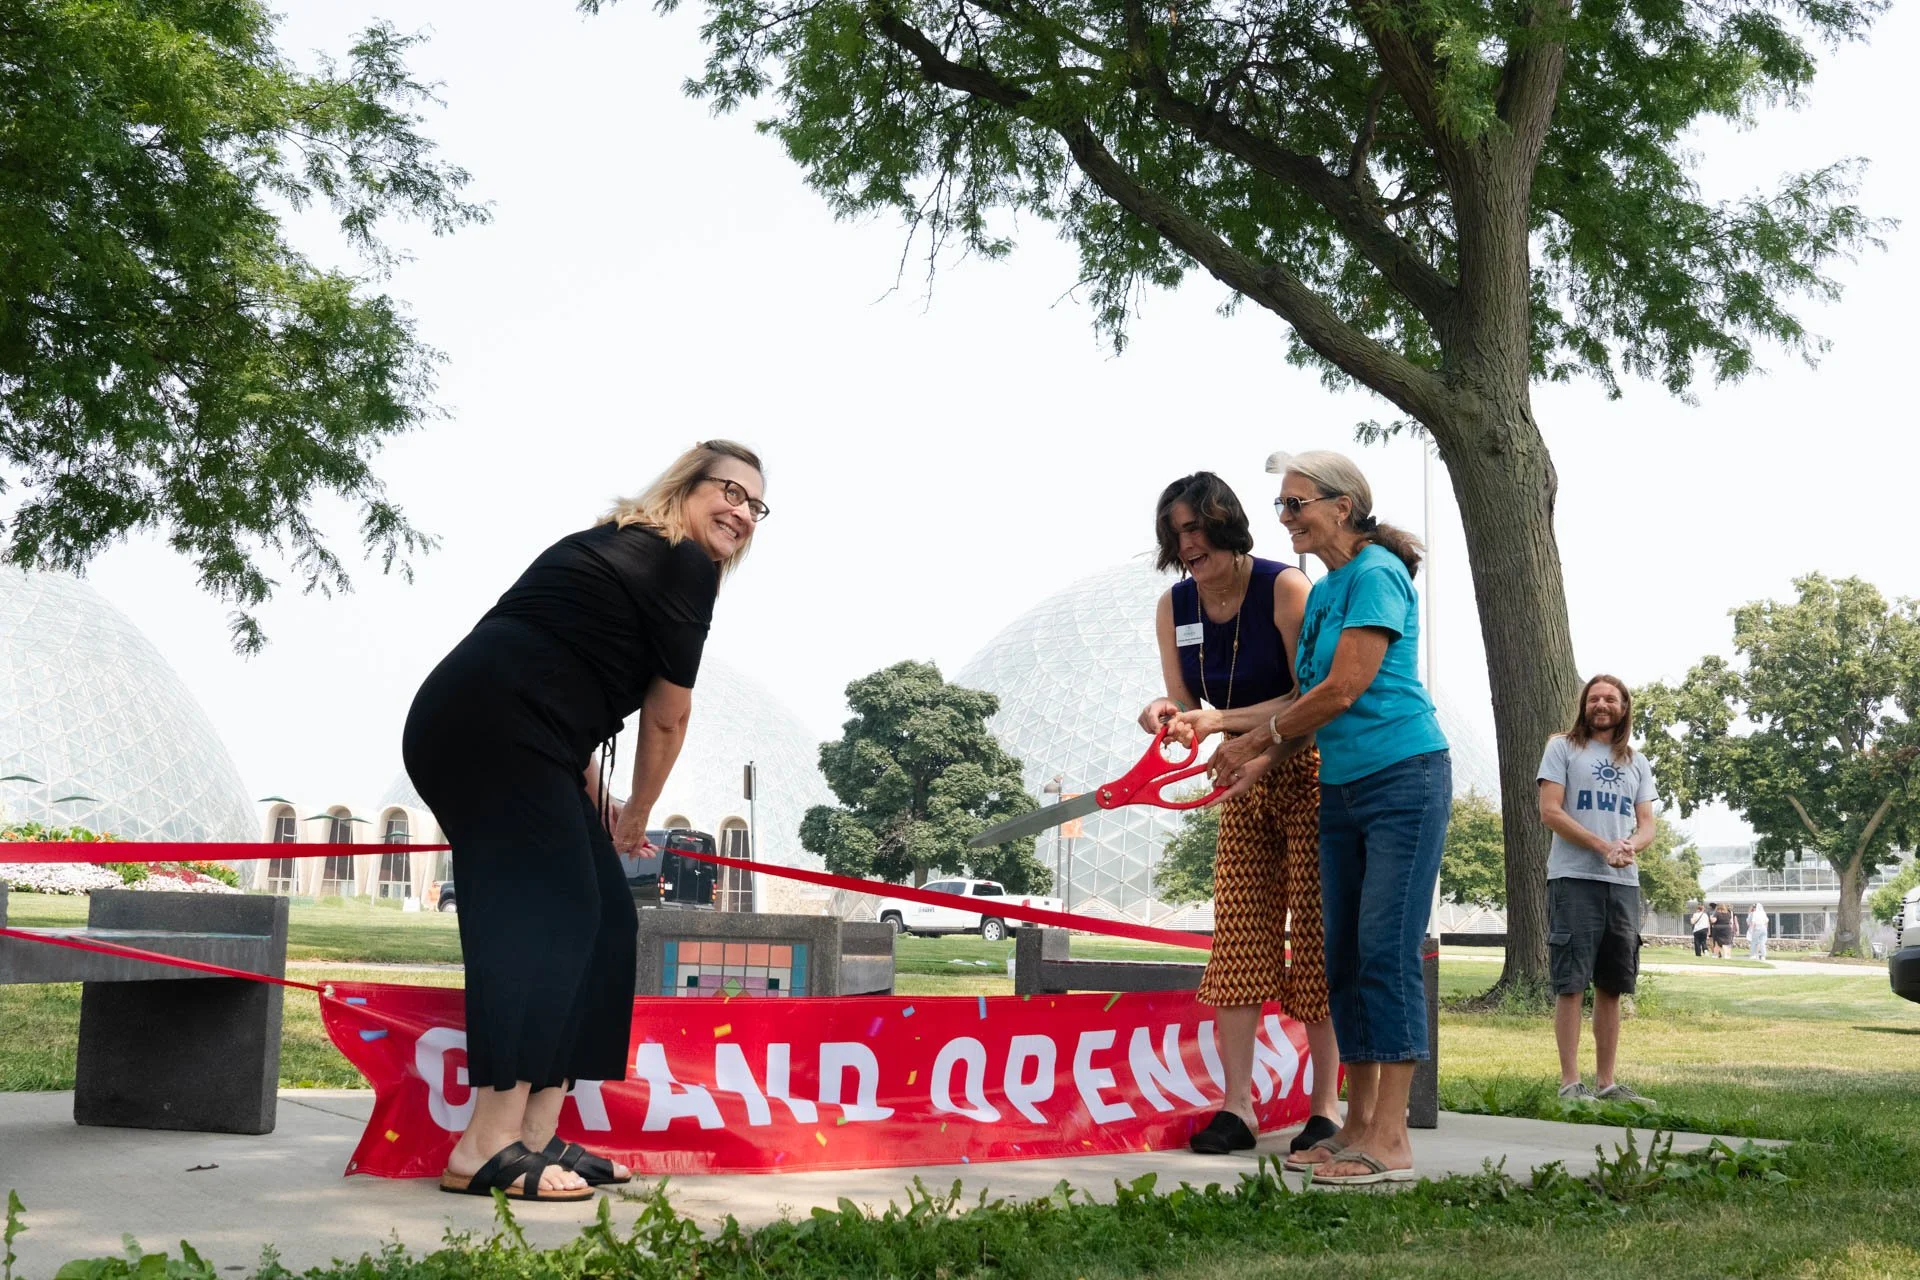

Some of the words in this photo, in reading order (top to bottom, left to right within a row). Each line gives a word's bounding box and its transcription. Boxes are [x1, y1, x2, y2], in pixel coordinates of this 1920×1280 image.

[1577, 789, 1632, 818] AWE
[415, 1026, 896, 1132] GAND
[930, 1014, 1314, 1125] OPENIN
